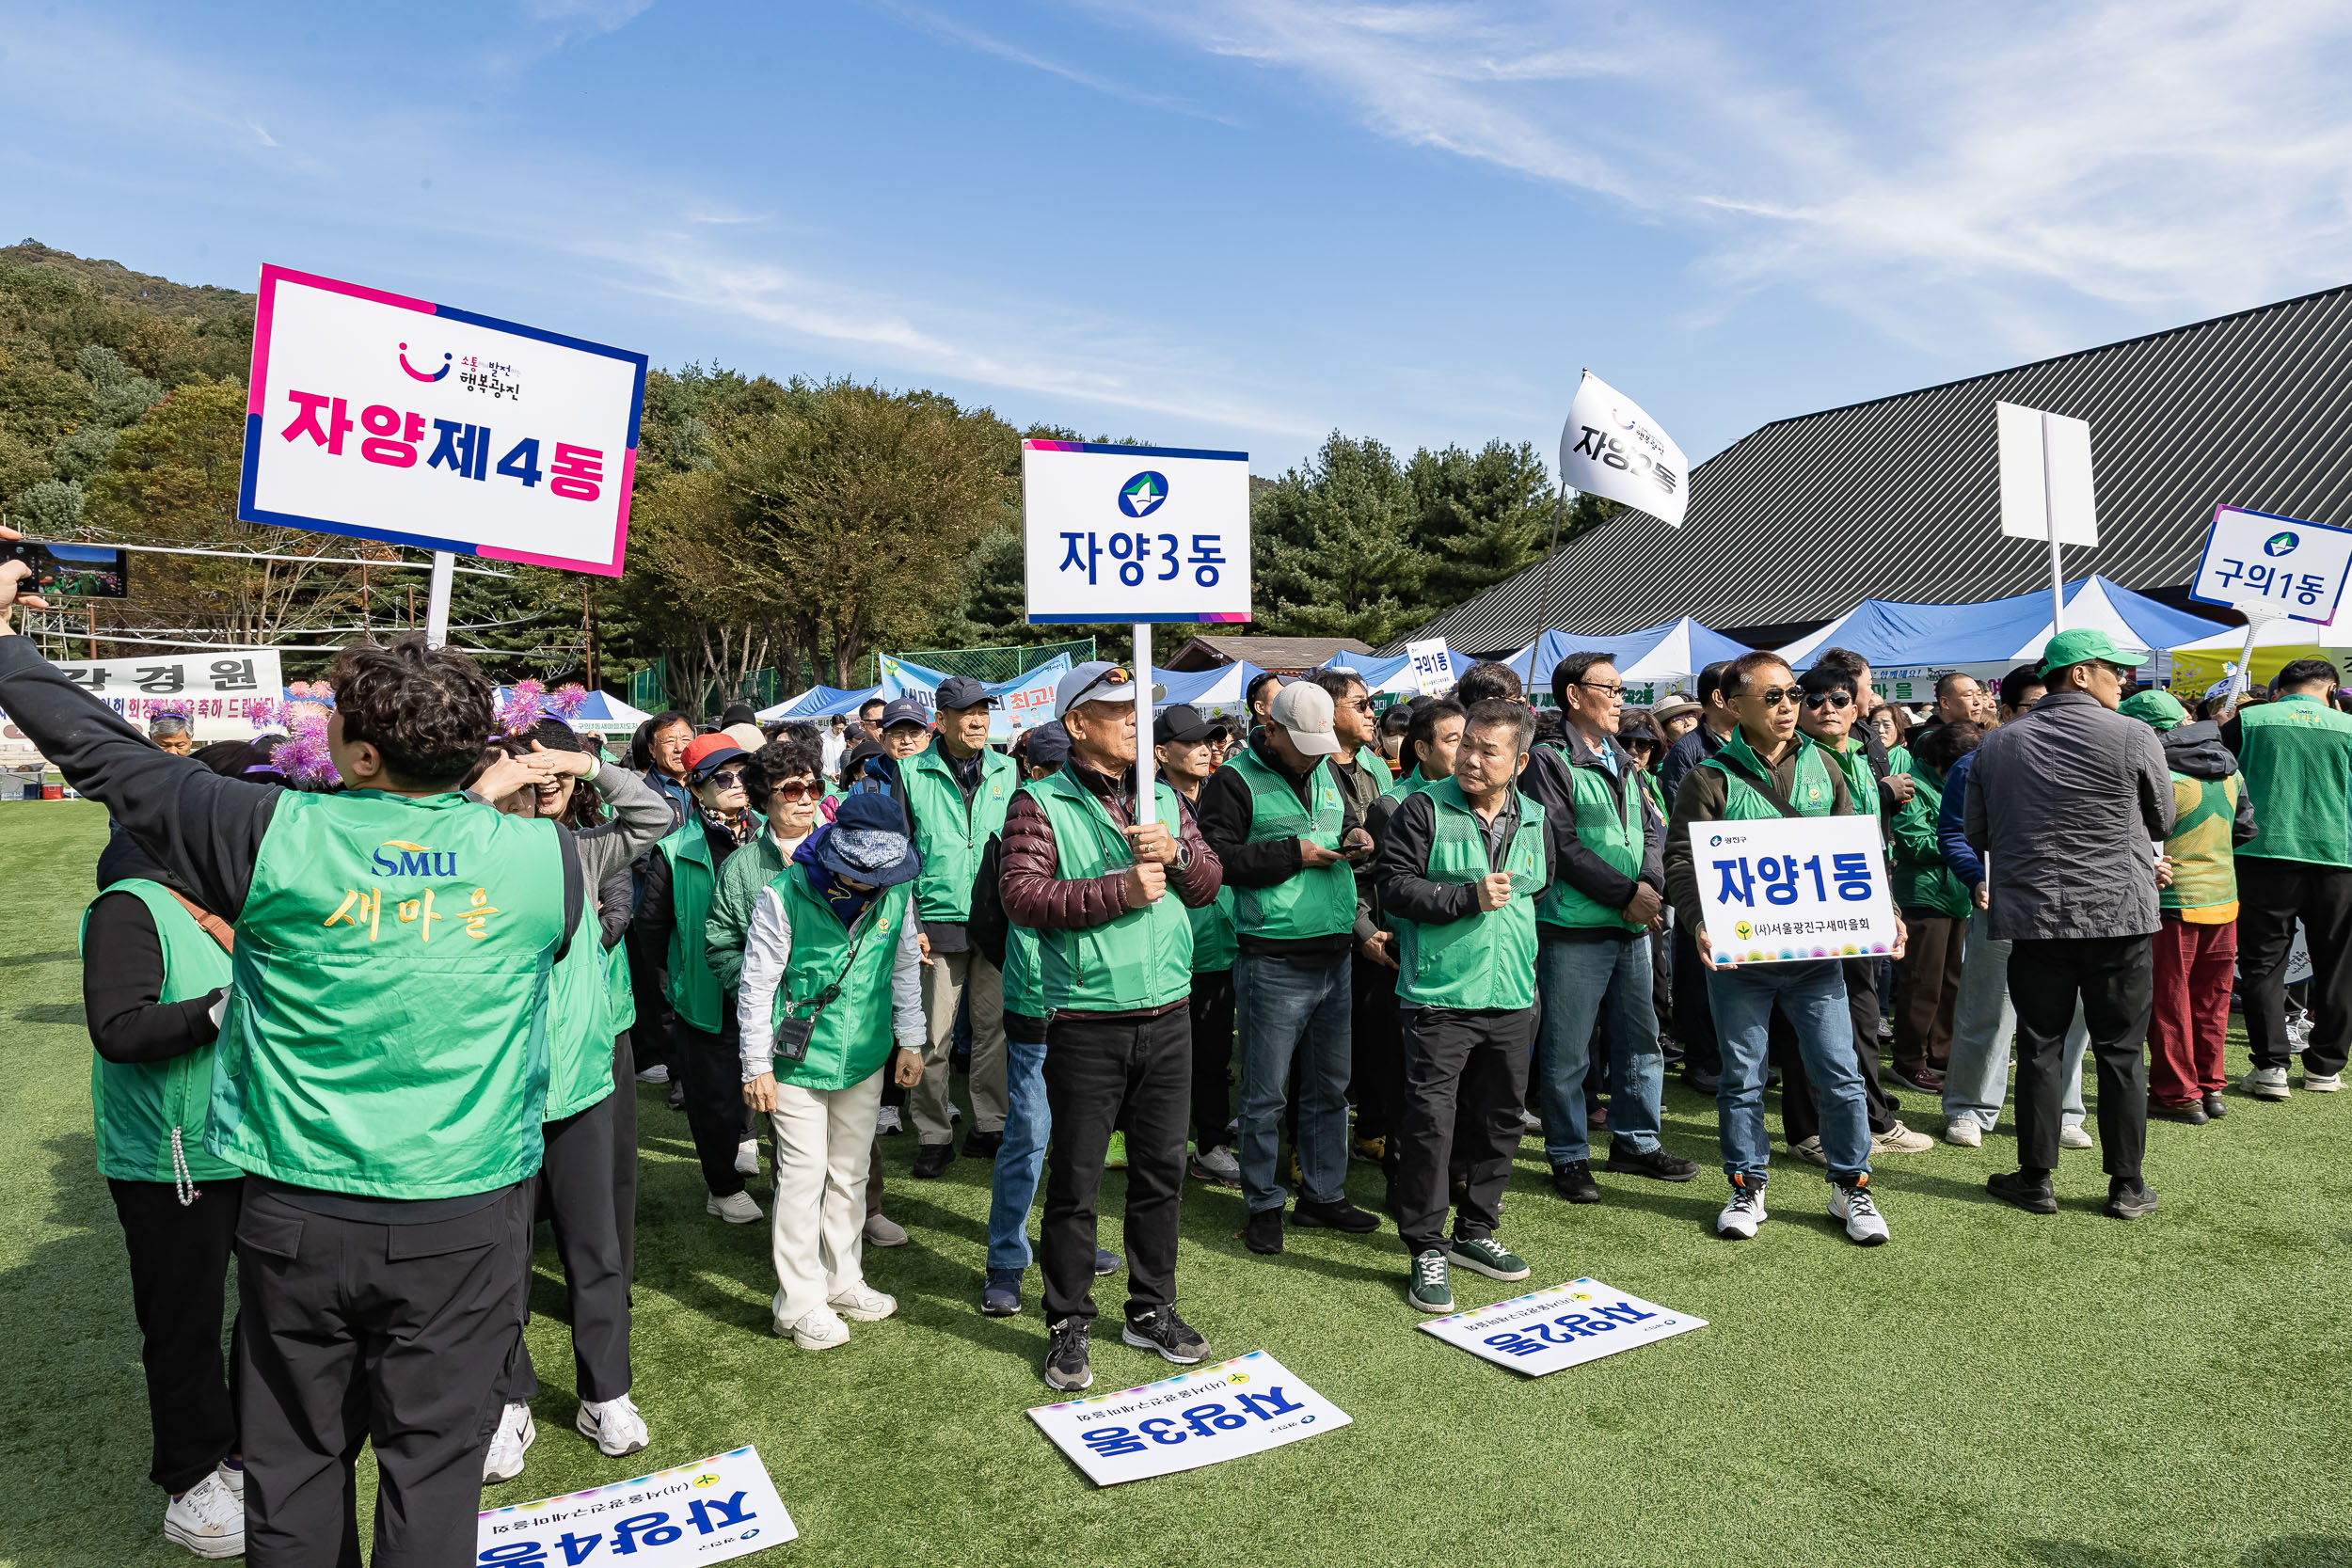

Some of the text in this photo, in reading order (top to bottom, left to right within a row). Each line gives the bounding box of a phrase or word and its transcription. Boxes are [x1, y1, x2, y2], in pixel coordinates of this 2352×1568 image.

[459, 372, 519, 401] 행복광진
[281, 389, 603, 501] 자양제4동
[1058, 531, 1226, 587] 자양3동
[2215, 558, 2325, 605] 구의1동
[1414, 652, 1448, 676] 구의1동
[1009, 685, 1056, 710] 최고!
[372, 847, 458, 877] SMU
[1712, 853, 1872, 907] 자양1동
[323, 887, 500, 942] 새마을
[1755, 918, 1869, 936] (사)서울광진구새마을회
[1483, 1302, 1659, 1356] 자양2동
[1075, 1379, 1227, 1423] (사)서울광진구새마을회
[1080, 1386, 1306, 1458] 자양3동
[476, 1491, 757, 1568] 자양4동
[492, 1481, 690, 1535] (사)서울광진구새마을회
